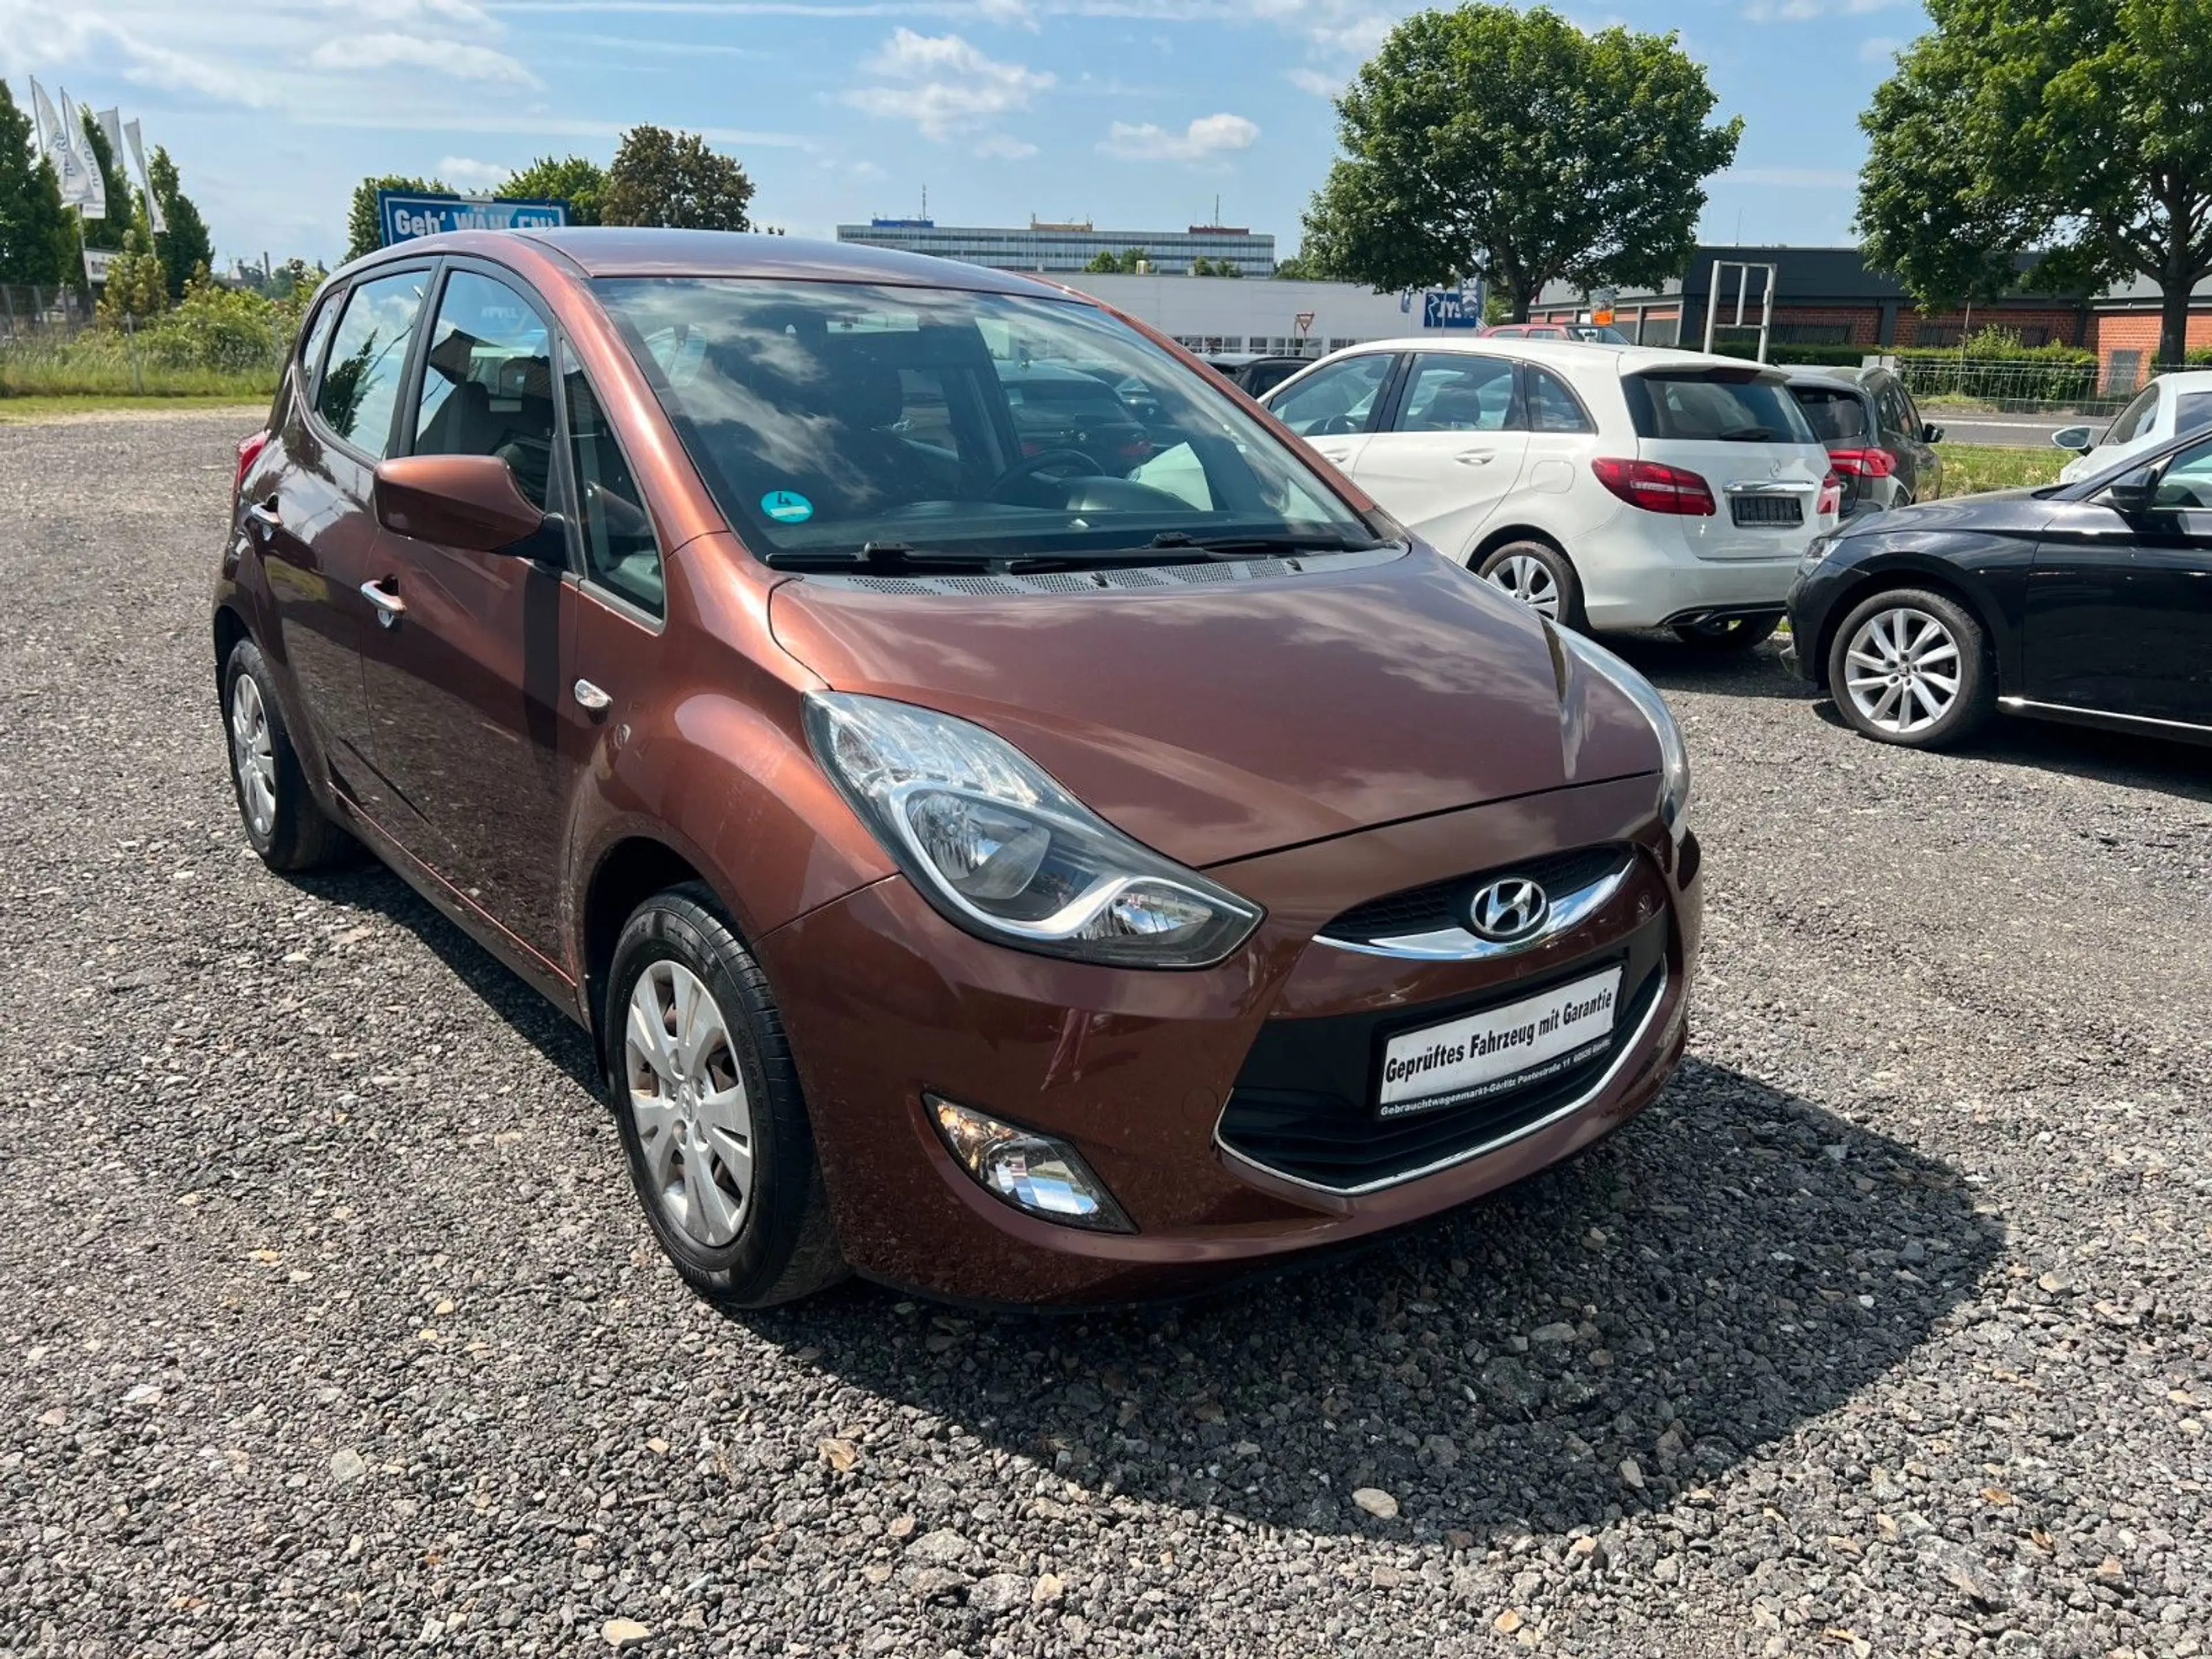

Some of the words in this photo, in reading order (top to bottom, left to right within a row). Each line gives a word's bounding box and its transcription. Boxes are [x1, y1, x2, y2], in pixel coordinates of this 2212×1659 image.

[1437, 301, 1476, 319] JYS
[1385, 1044, 1465, 1083] Geprüftes
[1470, 1023, 1535, 1058] Fahrzeug
[1539, 1009, 1559, 1036] mit
[1563, 987, 1612, 1025] Garantie
